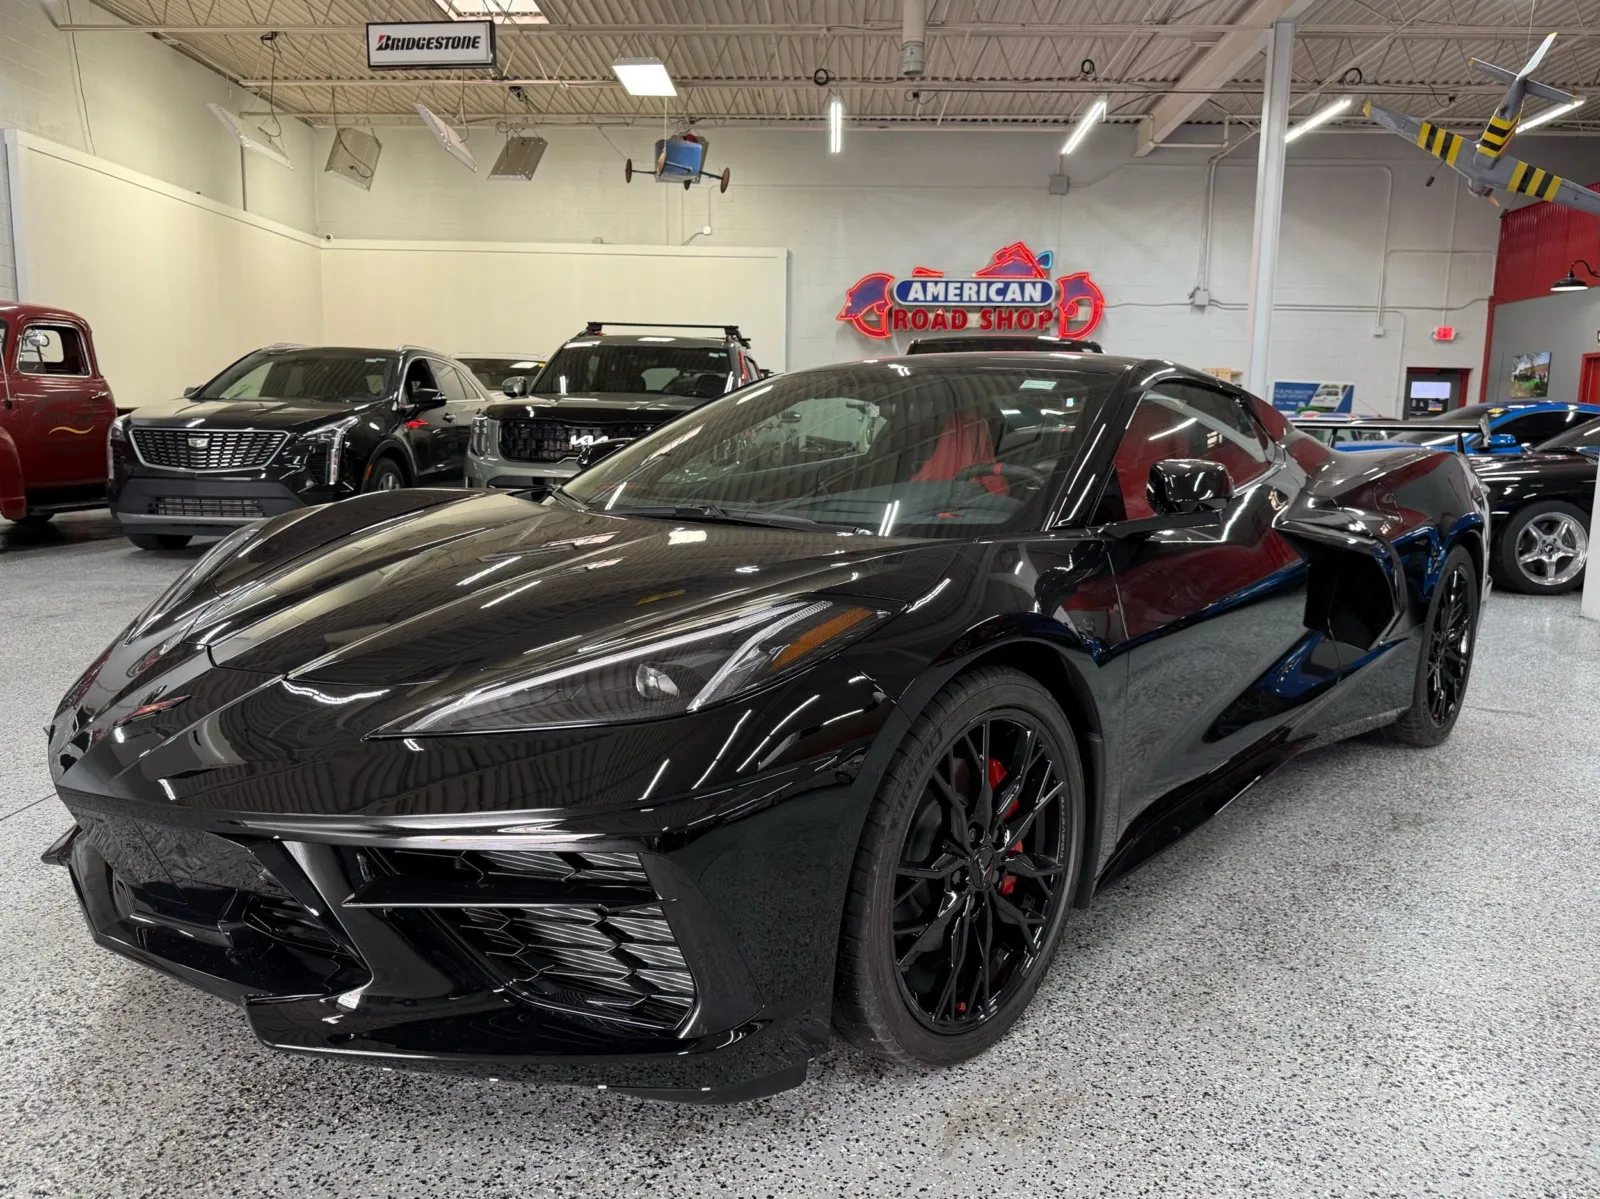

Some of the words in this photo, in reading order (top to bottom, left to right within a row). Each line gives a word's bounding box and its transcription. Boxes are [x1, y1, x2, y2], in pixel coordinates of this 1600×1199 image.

[375, 34, 481, 51] BRIDGESTONE
[907, 282, 1042, 302] AMERICAN
[893, 308, 968, 331] ROAD
[979, 308, 1053, 331] SHOP
